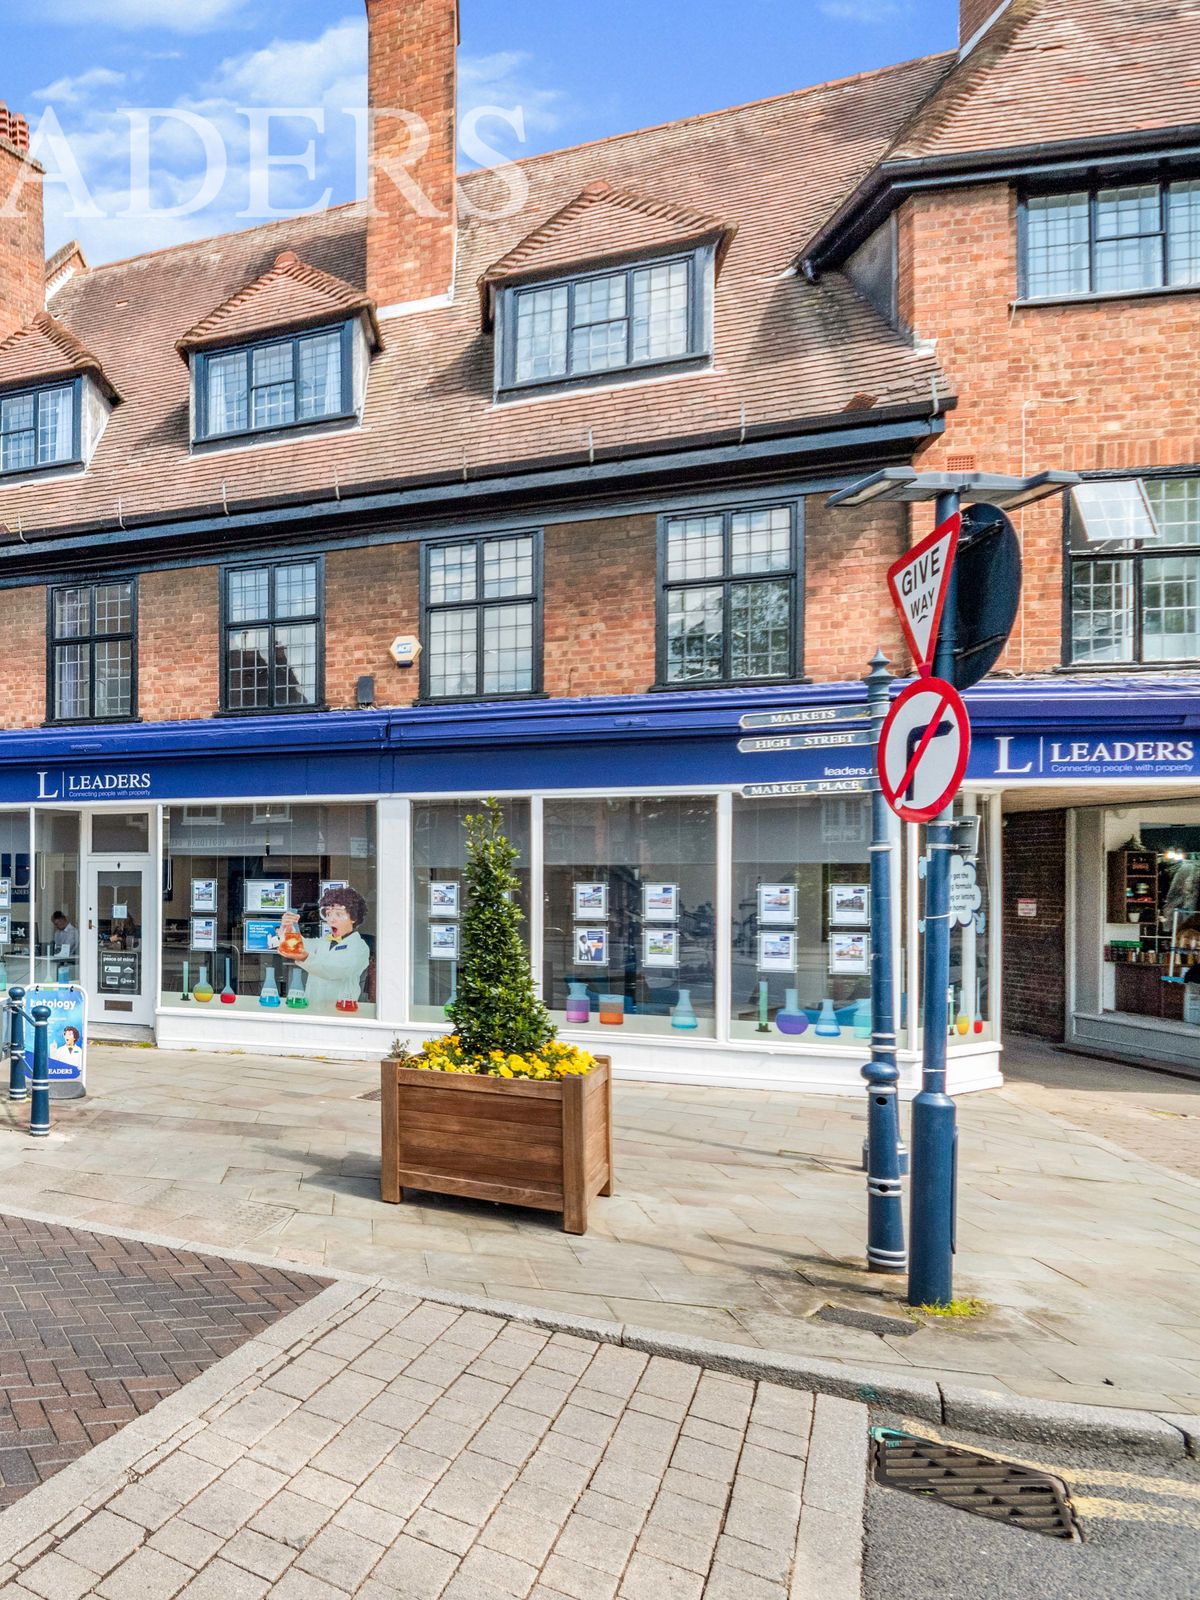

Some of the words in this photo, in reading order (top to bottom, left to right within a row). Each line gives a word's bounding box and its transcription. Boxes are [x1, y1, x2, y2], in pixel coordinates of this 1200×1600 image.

[901, 546, 940, 597] GIVE
[910, 587, 935, 619] WAY
[770, 709, 836, 723] MARKETS
[755, 738, 791, 749] HIGH
[804, 733, 855, 745] STREET
[993, 736, 1032, 773] L
[1050, 741, 1194, 762] LEADERS
[1051, 764, 1101, 772] Connecting
[1102, 764, 1133, 772] people
[1155, 763, 1194, 772] property
[36, 771, 59, 799] L
[68, 773, 151, 790] LEADERS
[751, 784, 807, 795] MARKET
[818, 781, 860, 791] PLACE
[30, 999, 76, 1009] Letology
